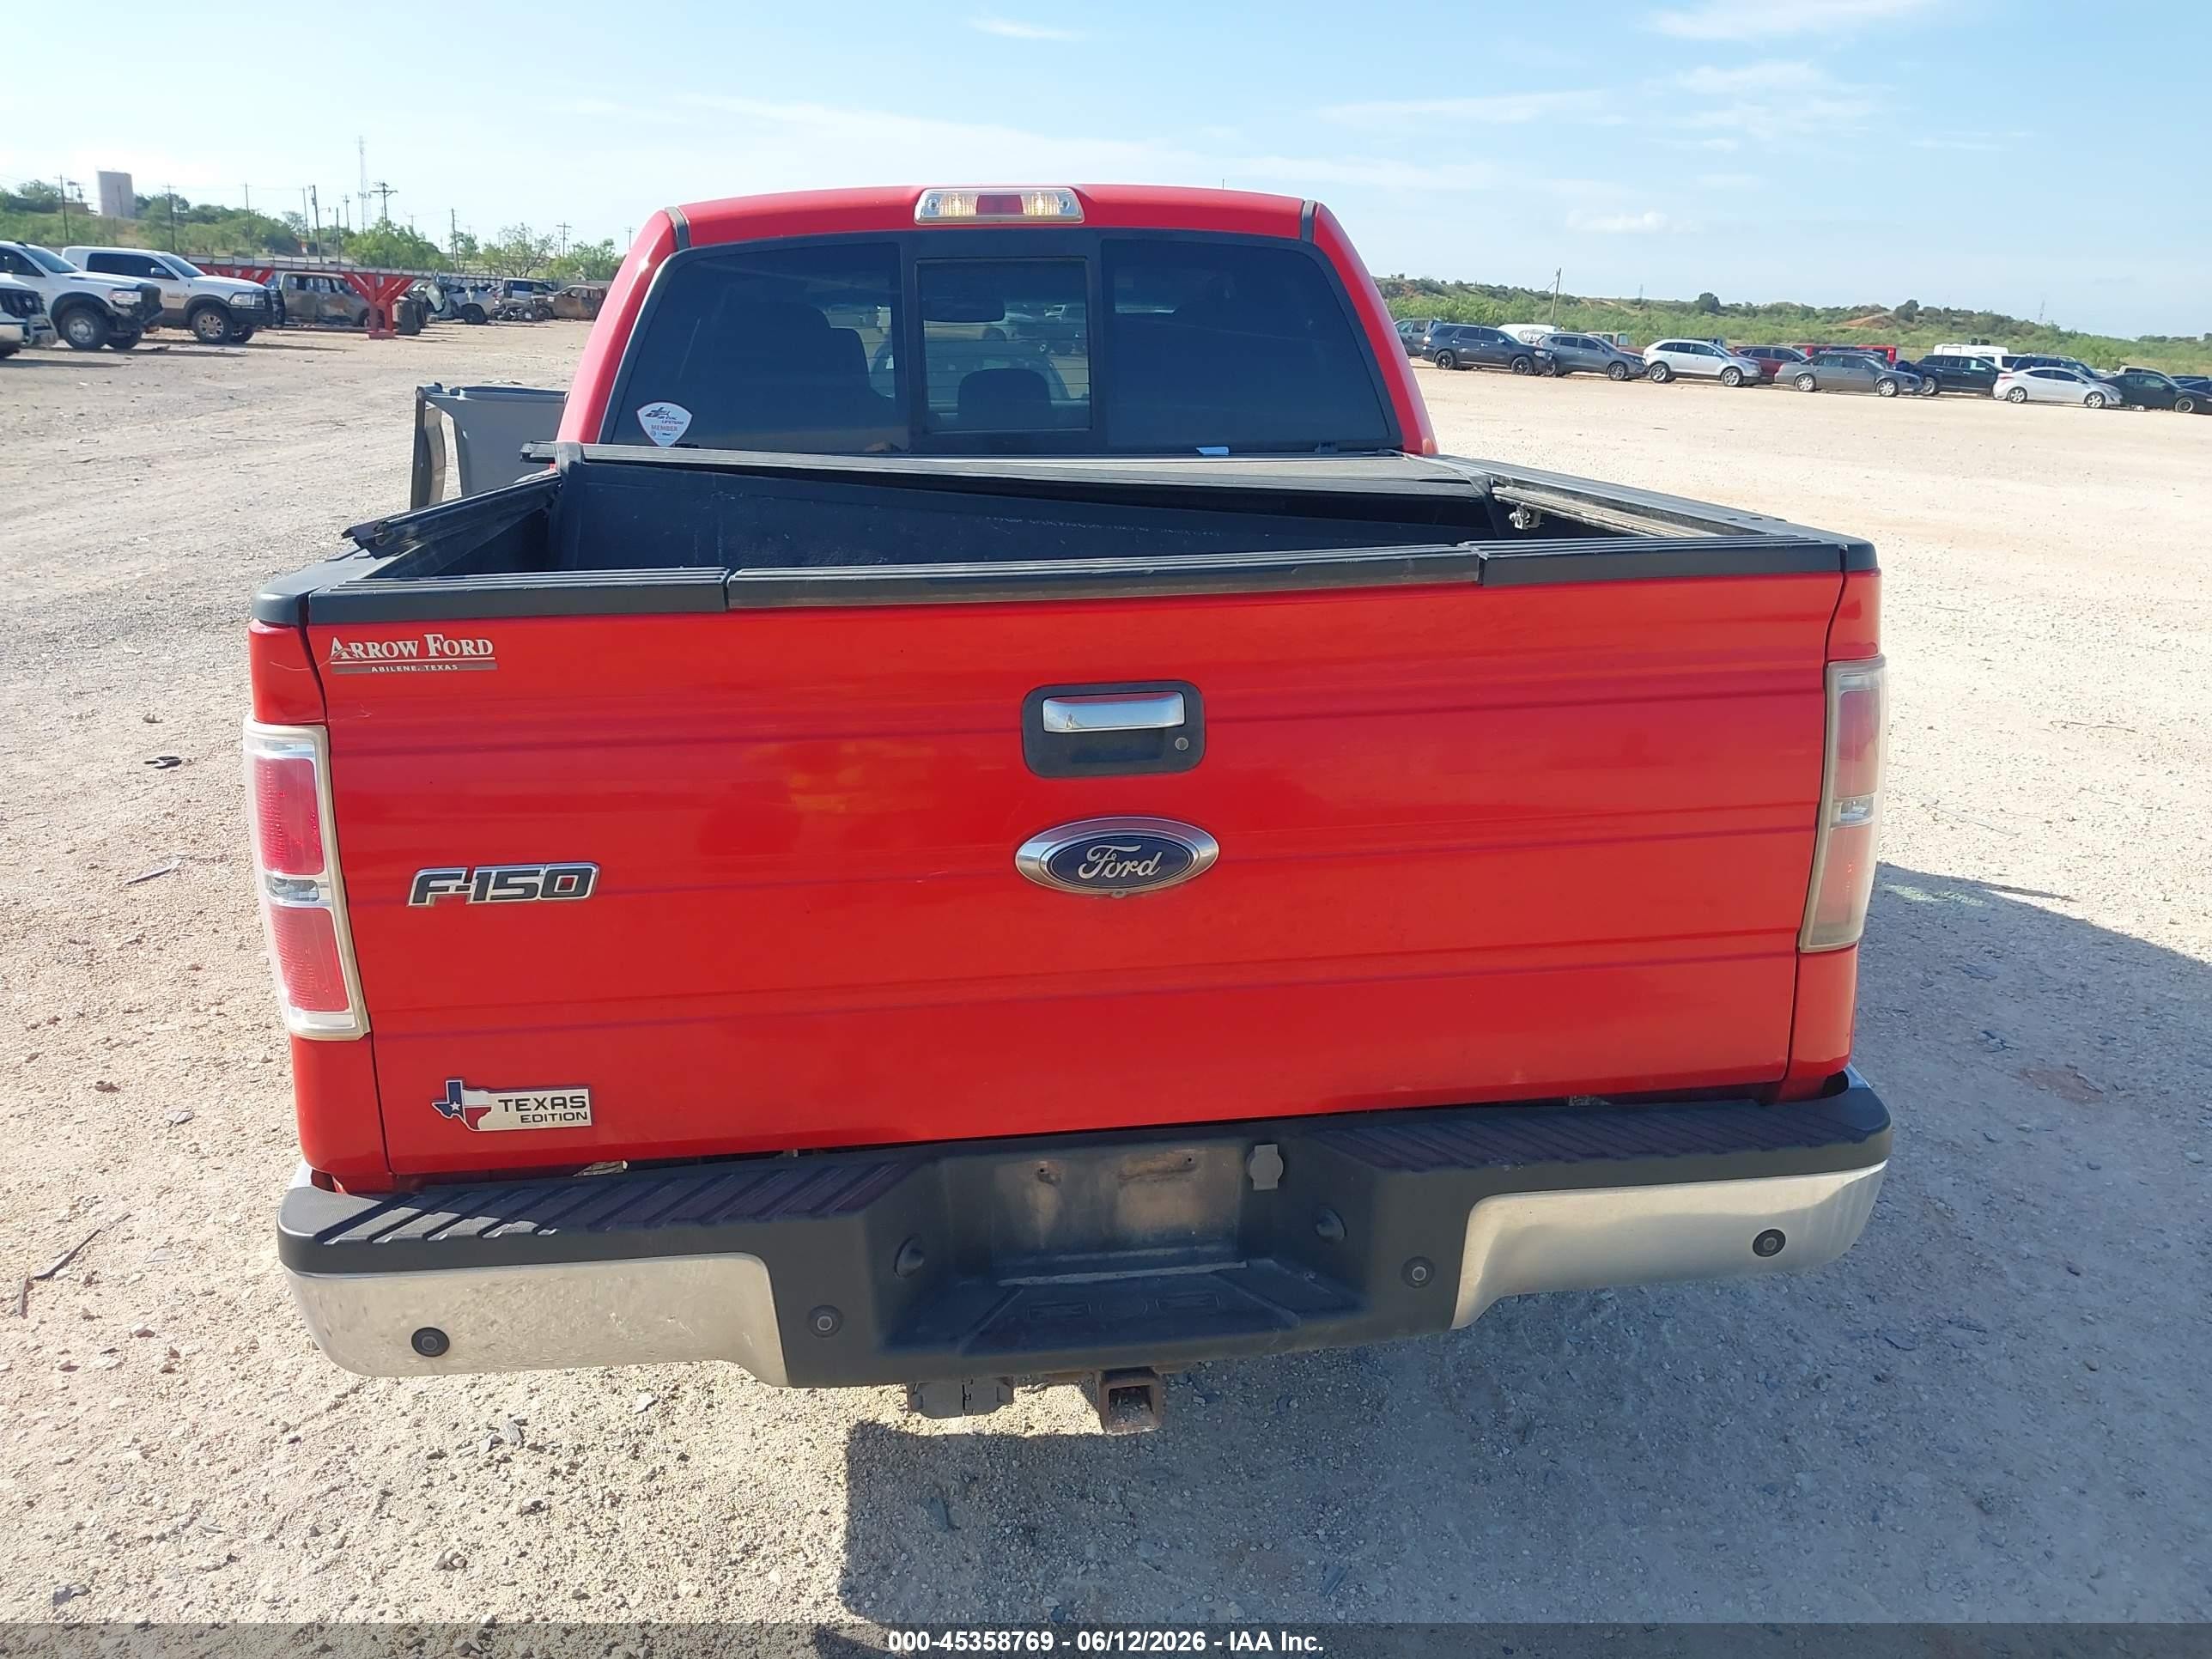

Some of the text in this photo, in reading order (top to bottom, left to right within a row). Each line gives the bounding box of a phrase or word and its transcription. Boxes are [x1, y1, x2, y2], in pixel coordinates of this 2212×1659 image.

[330, 634, 494, 659] ARROW FORD
[1078, 844, 1163, 879] Ford
[407, 861, 599, 907] F-150
[498, 1095, 586, 1112] TEXAS
[520, 1111, 588, 1123] EDITION
